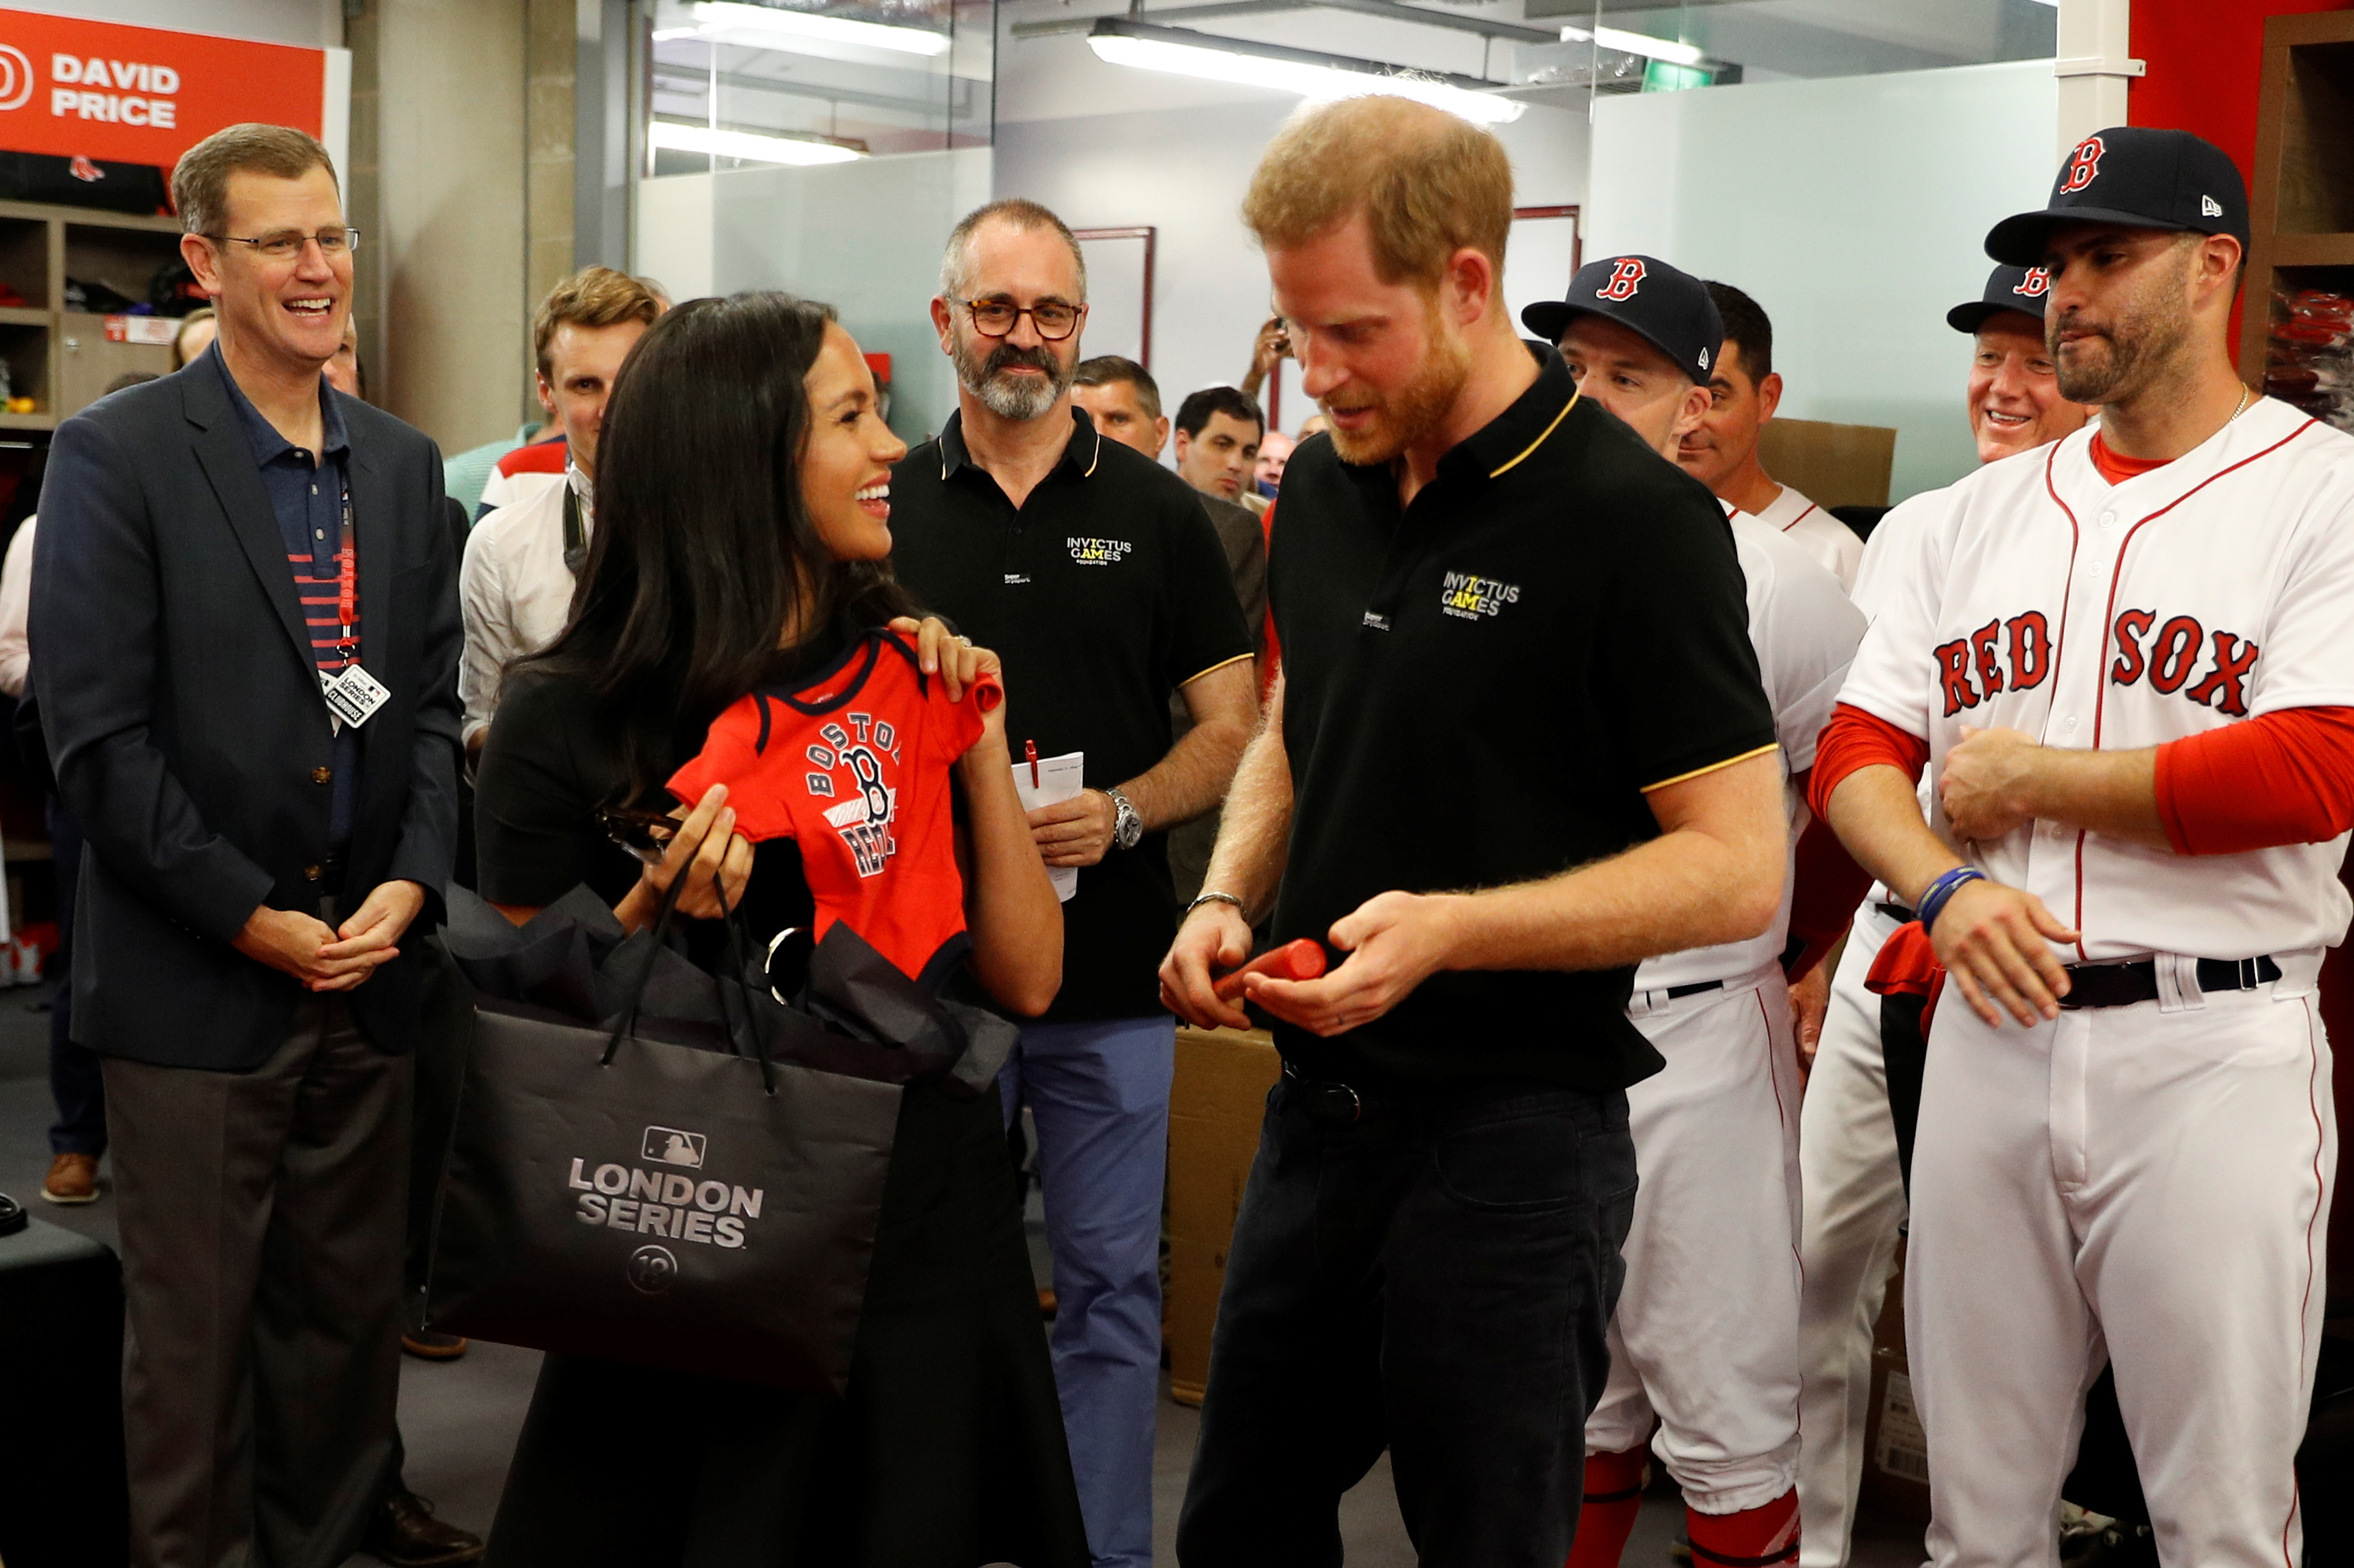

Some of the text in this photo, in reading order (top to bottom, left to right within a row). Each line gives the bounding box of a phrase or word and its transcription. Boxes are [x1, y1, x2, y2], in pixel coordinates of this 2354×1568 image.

[52, 52, 180, 95] DAVID
[50, 87, 176, 129] PRICE
[2059, 136, 2106, 195] B
[1596, 257, 1647, 302] B
[1067, 537, 1132, 553] INVICTUS
[1070, 548, 1122, 562] GAMES
[1442, 589, 1500, 617] GAMES
[1443, 571, 1520, 603] INVICTUS
[1933, 608, 2259, 718] RED SOX
[327, 690, 362, 721] CLUBHOUSE
[339, 681, 366, 705] SERIES
[343, 677, 376, 705] LONDON
[806, 713, 902, 798] BOSTO
[839, 745, 891, 828] B
[569, 1157, 764, 1219] LONDON
[575, 1192, 746, 1249] SERIES
